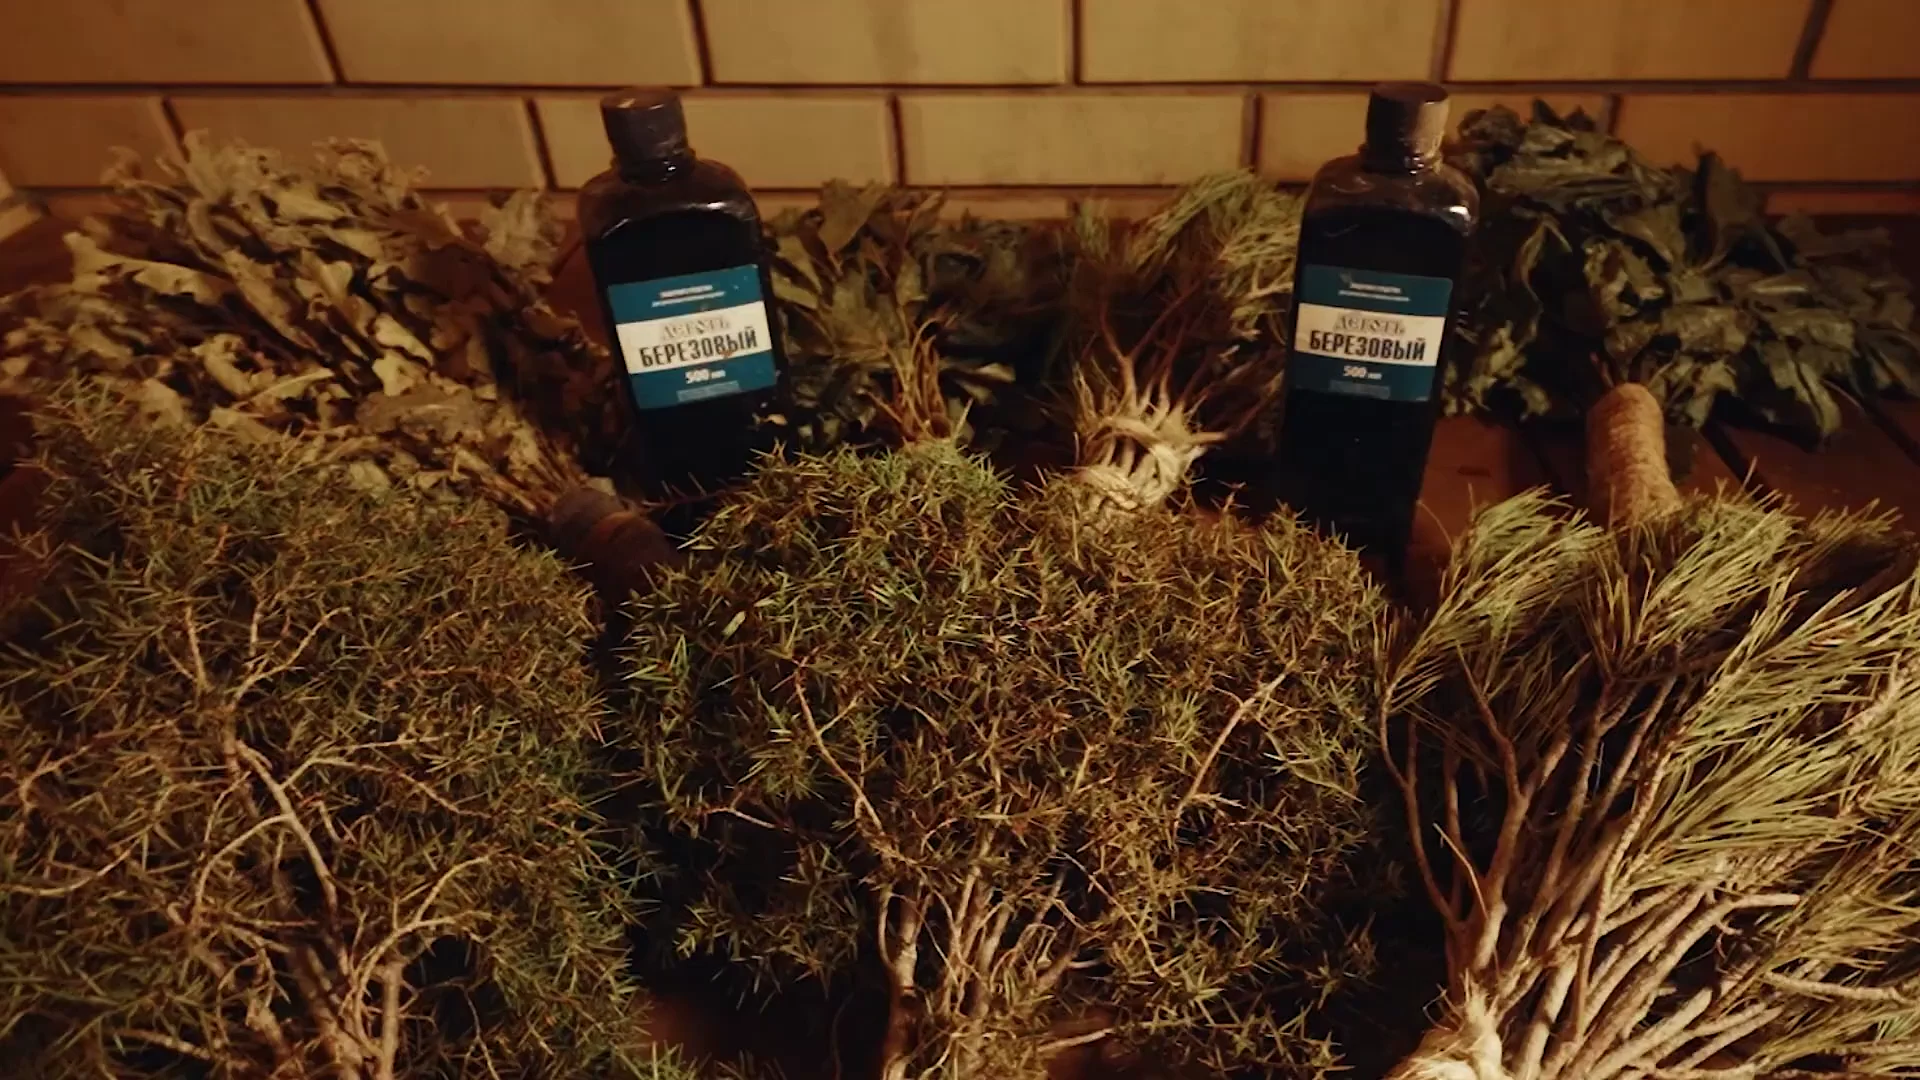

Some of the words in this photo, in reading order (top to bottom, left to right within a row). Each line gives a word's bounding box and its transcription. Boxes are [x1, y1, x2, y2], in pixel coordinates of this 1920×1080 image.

[639, 326, 758, 368] БЕРЕЗОВЫЙ
[1309, 330, 1427, 361] БЕРЕЗОВЫЙ
[685, 368, 711, 384] 500
[1343, 365, 1368, 378] 500
